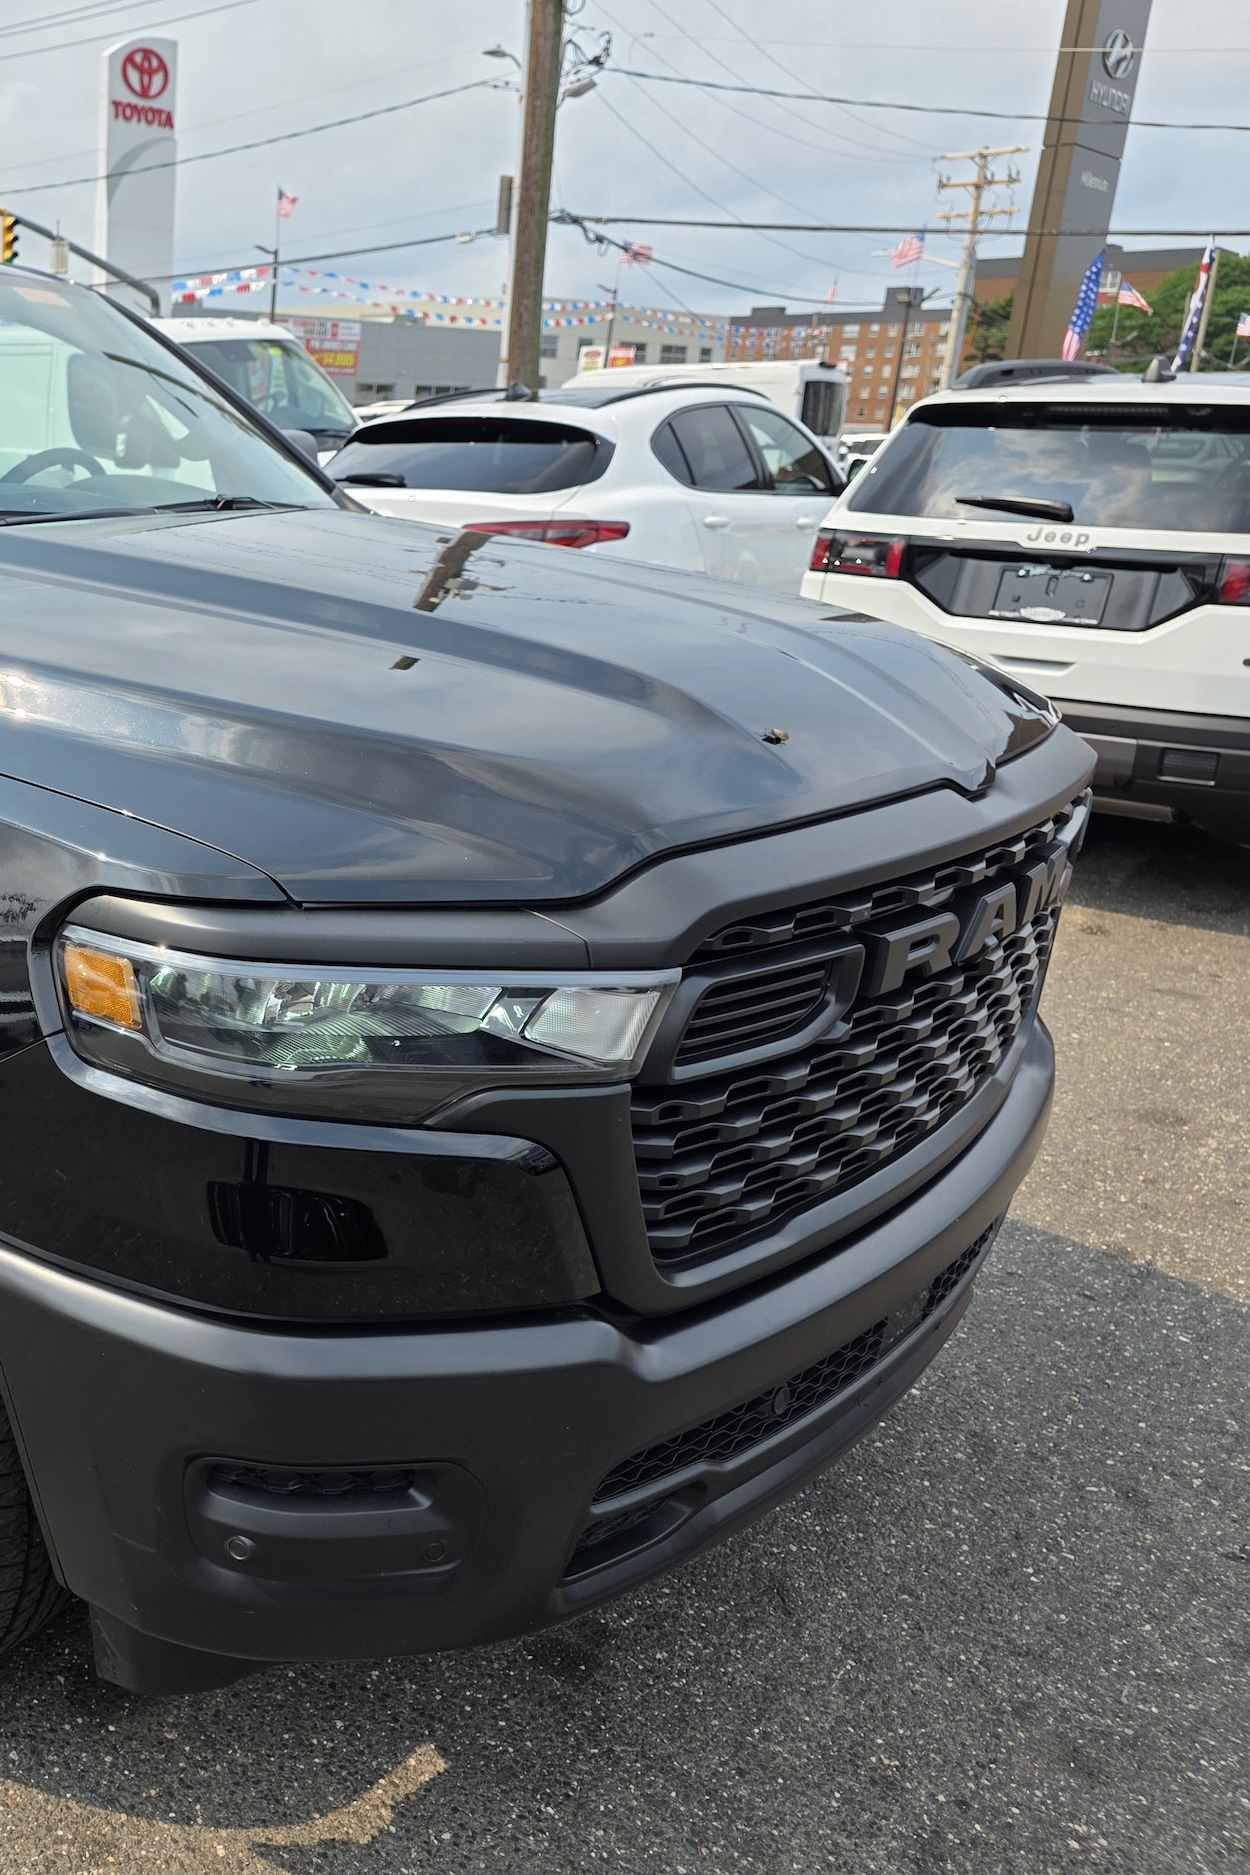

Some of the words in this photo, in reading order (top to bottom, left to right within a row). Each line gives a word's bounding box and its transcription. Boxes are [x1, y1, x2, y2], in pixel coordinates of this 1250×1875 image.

[1090, 80, 1131, 116] HYUNDAI
[112, 100, 174, 130] TOYOTA
[1027, 527, 1089, 547] Jeep
[868, 845, 1067, 998] RAM
